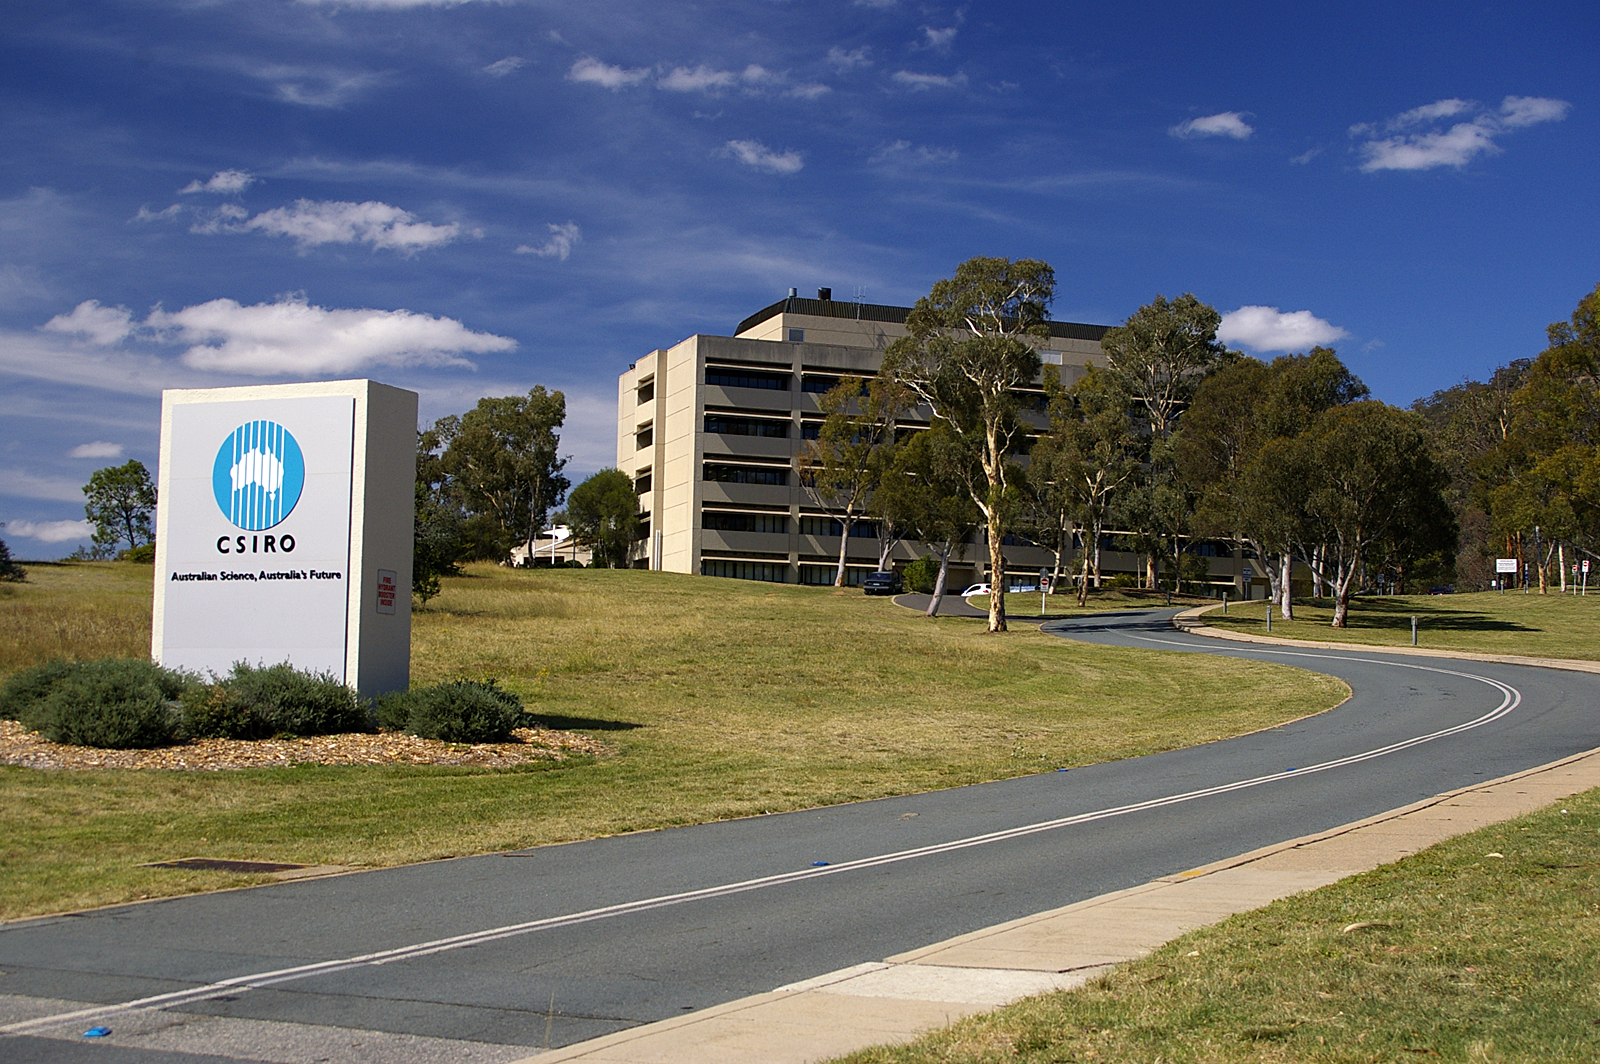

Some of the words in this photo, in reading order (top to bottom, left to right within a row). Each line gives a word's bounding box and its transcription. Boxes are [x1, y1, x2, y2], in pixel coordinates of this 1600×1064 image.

[216, 534, 296, 554] CSIRO
[171, 571, 218, 581] Australian
[220, 570, 258, 583] Science,
[259, 569, 308, 581] Australia's
[310, 569, 342, 580] Future
